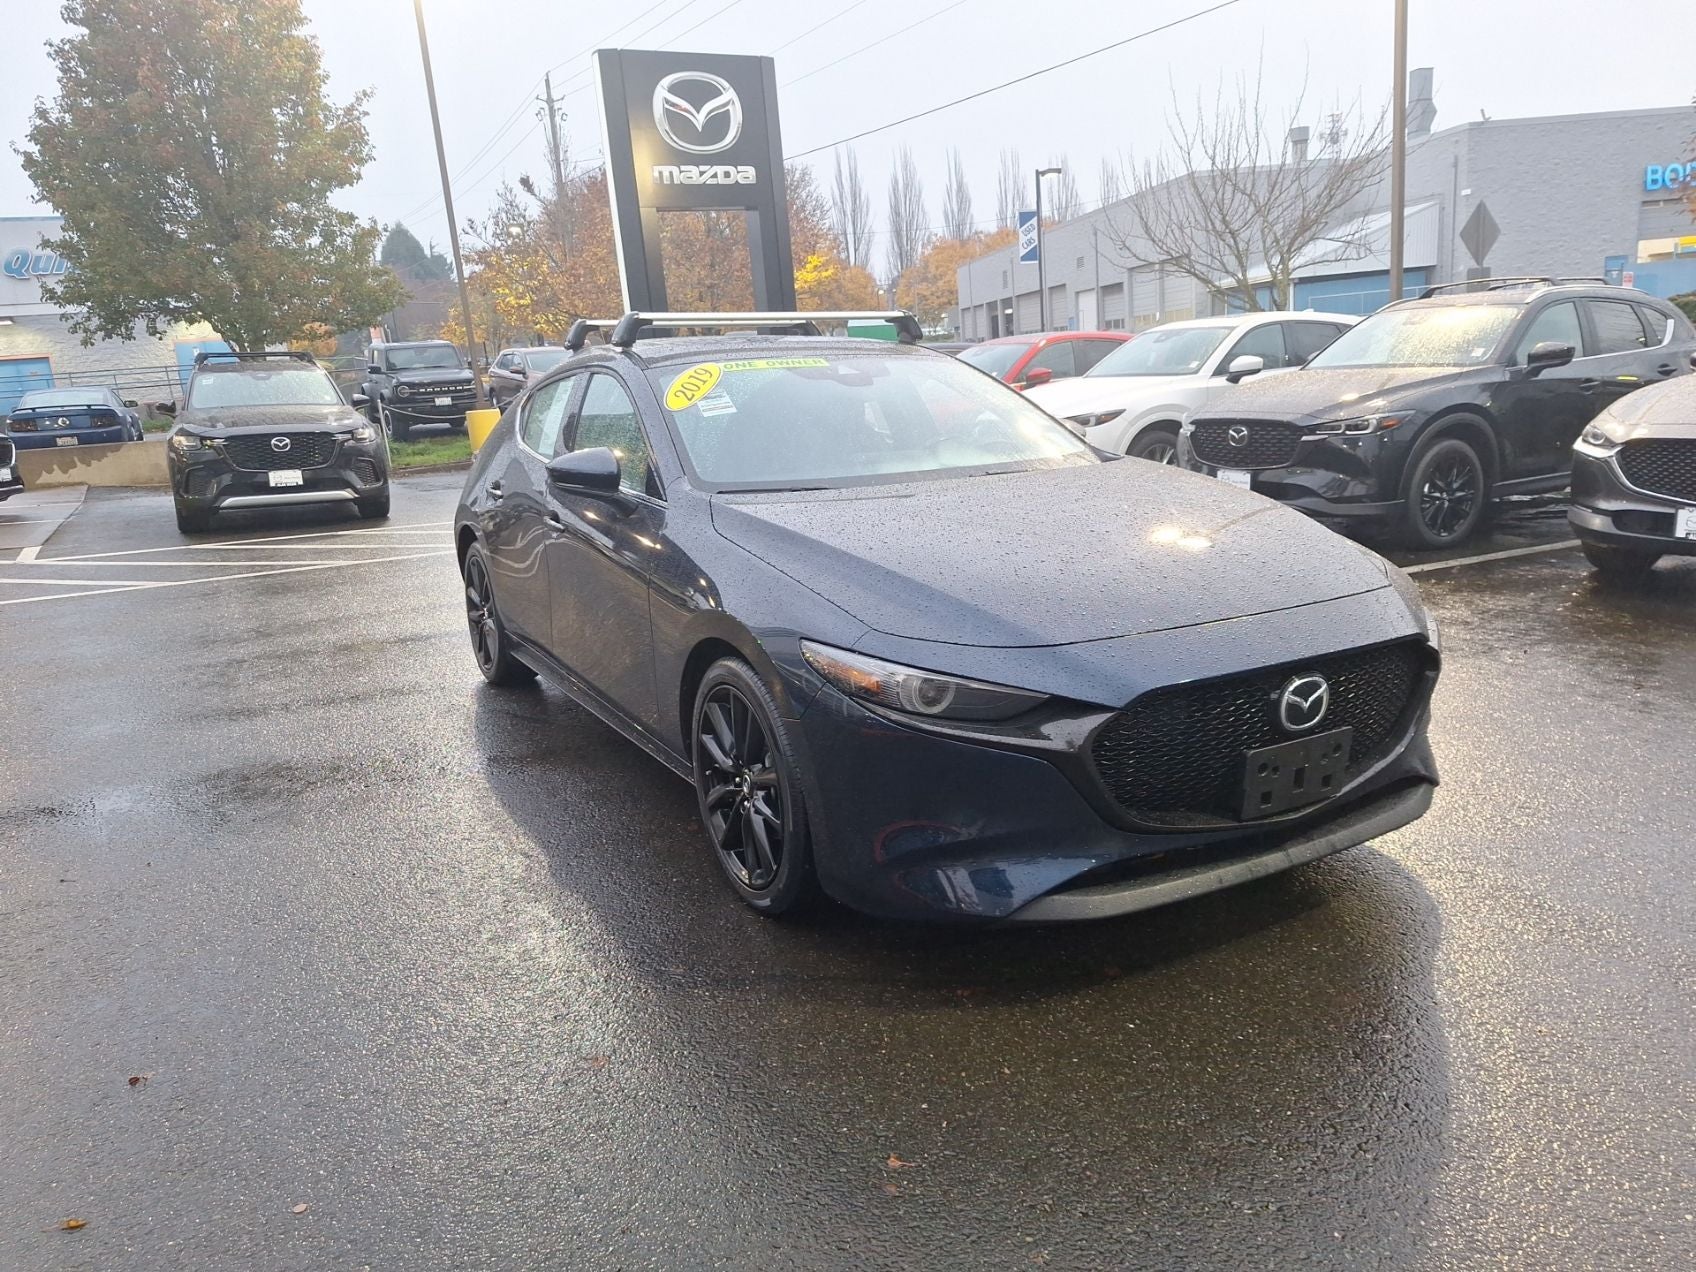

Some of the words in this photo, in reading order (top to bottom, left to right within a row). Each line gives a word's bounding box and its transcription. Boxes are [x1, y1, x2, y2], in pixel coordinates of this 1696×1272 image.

[652, 165, 757, 185] mazda
[1021, 223, 1036, 237] USED
[1021, 237, 1036, 250] CARS
[723, 361, 758, 371] ONE
[766, 359, 824, 368] OWNER
[674, 366, 713, 402] 2019
